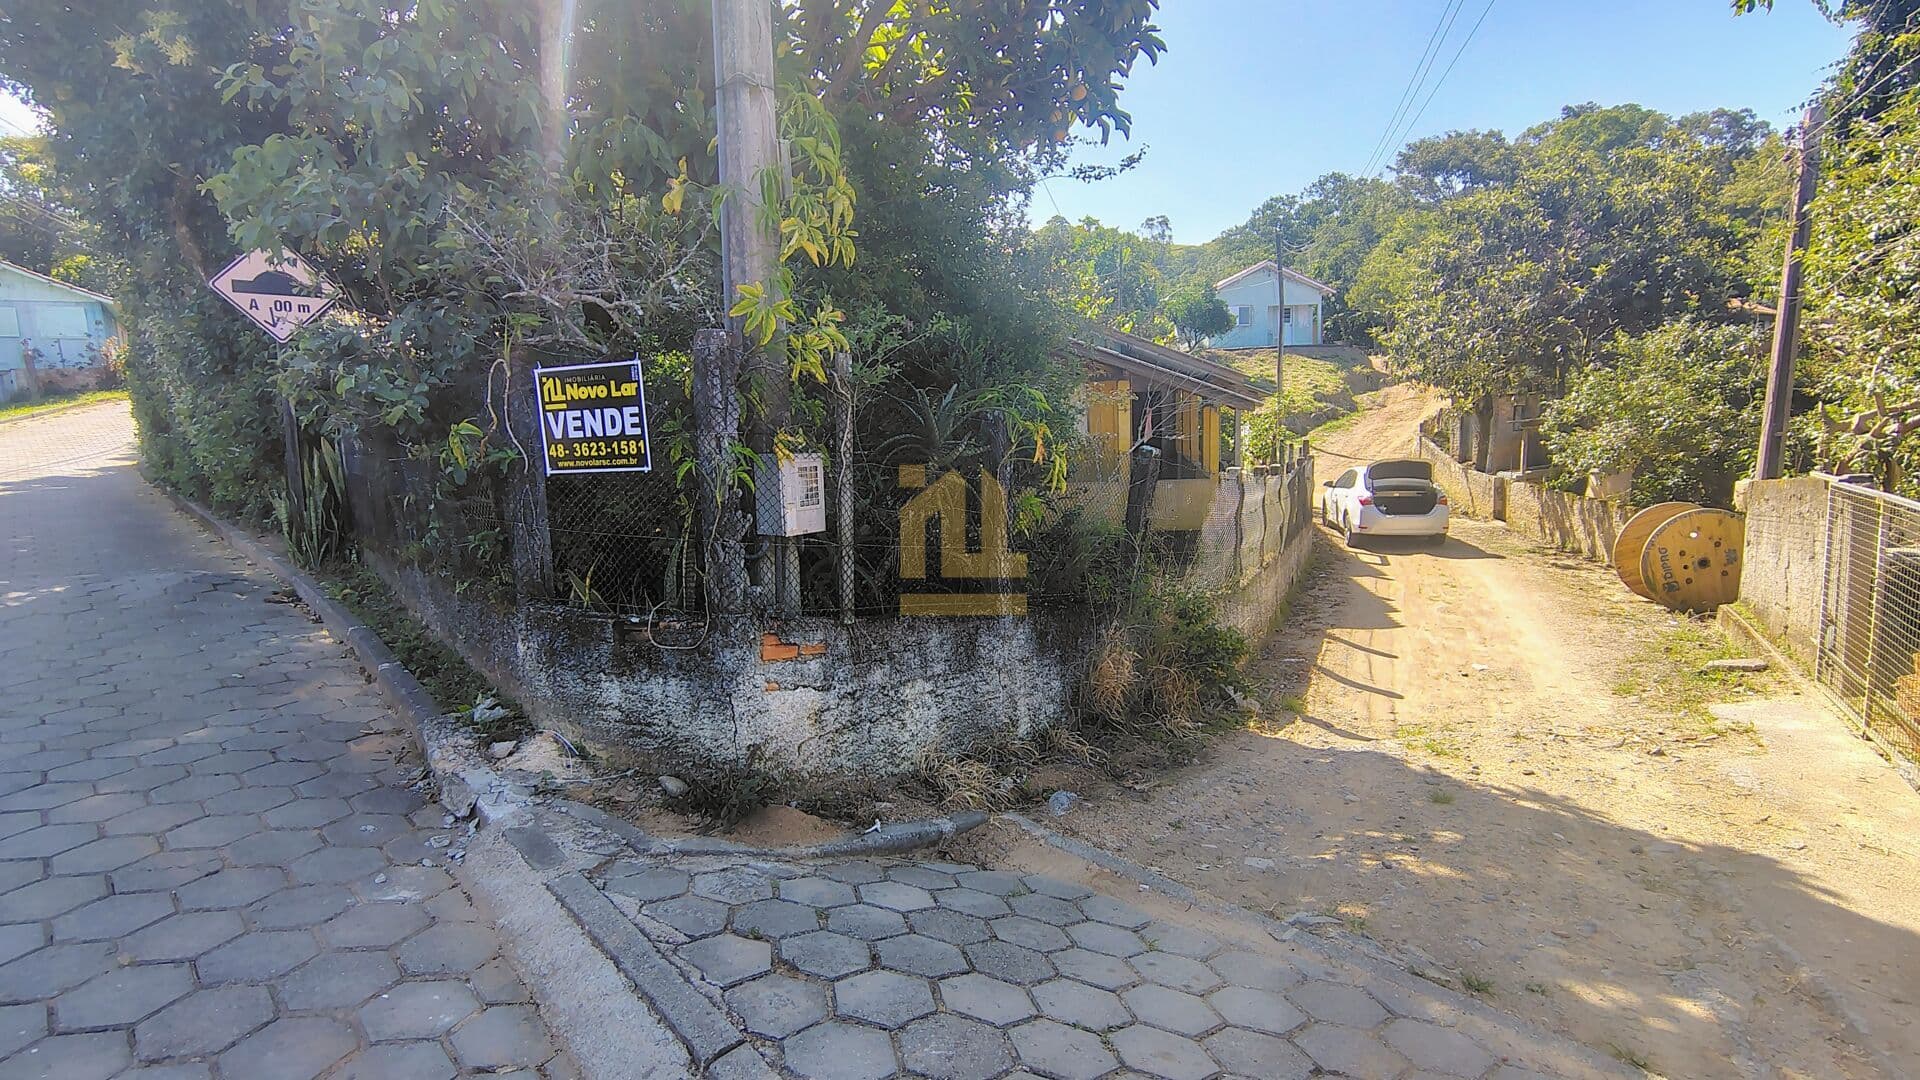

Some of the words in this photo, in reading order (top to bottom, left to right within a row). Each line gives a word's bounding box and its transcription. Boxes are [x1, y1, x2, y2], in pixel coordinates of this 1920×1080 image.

[249, 298, 259, 310] A
[297, 303, 310, 313] m
[565, 383, 608, 401] Novo
[610, 380, 638, 397] Lar
[546, 406, 642, 439] VENDE
[549, 443, 570, 458] 48-
[572, 440, 645, 457] 3623-1581
[557, 456, 638, 467] www.novolarsc.com.br
